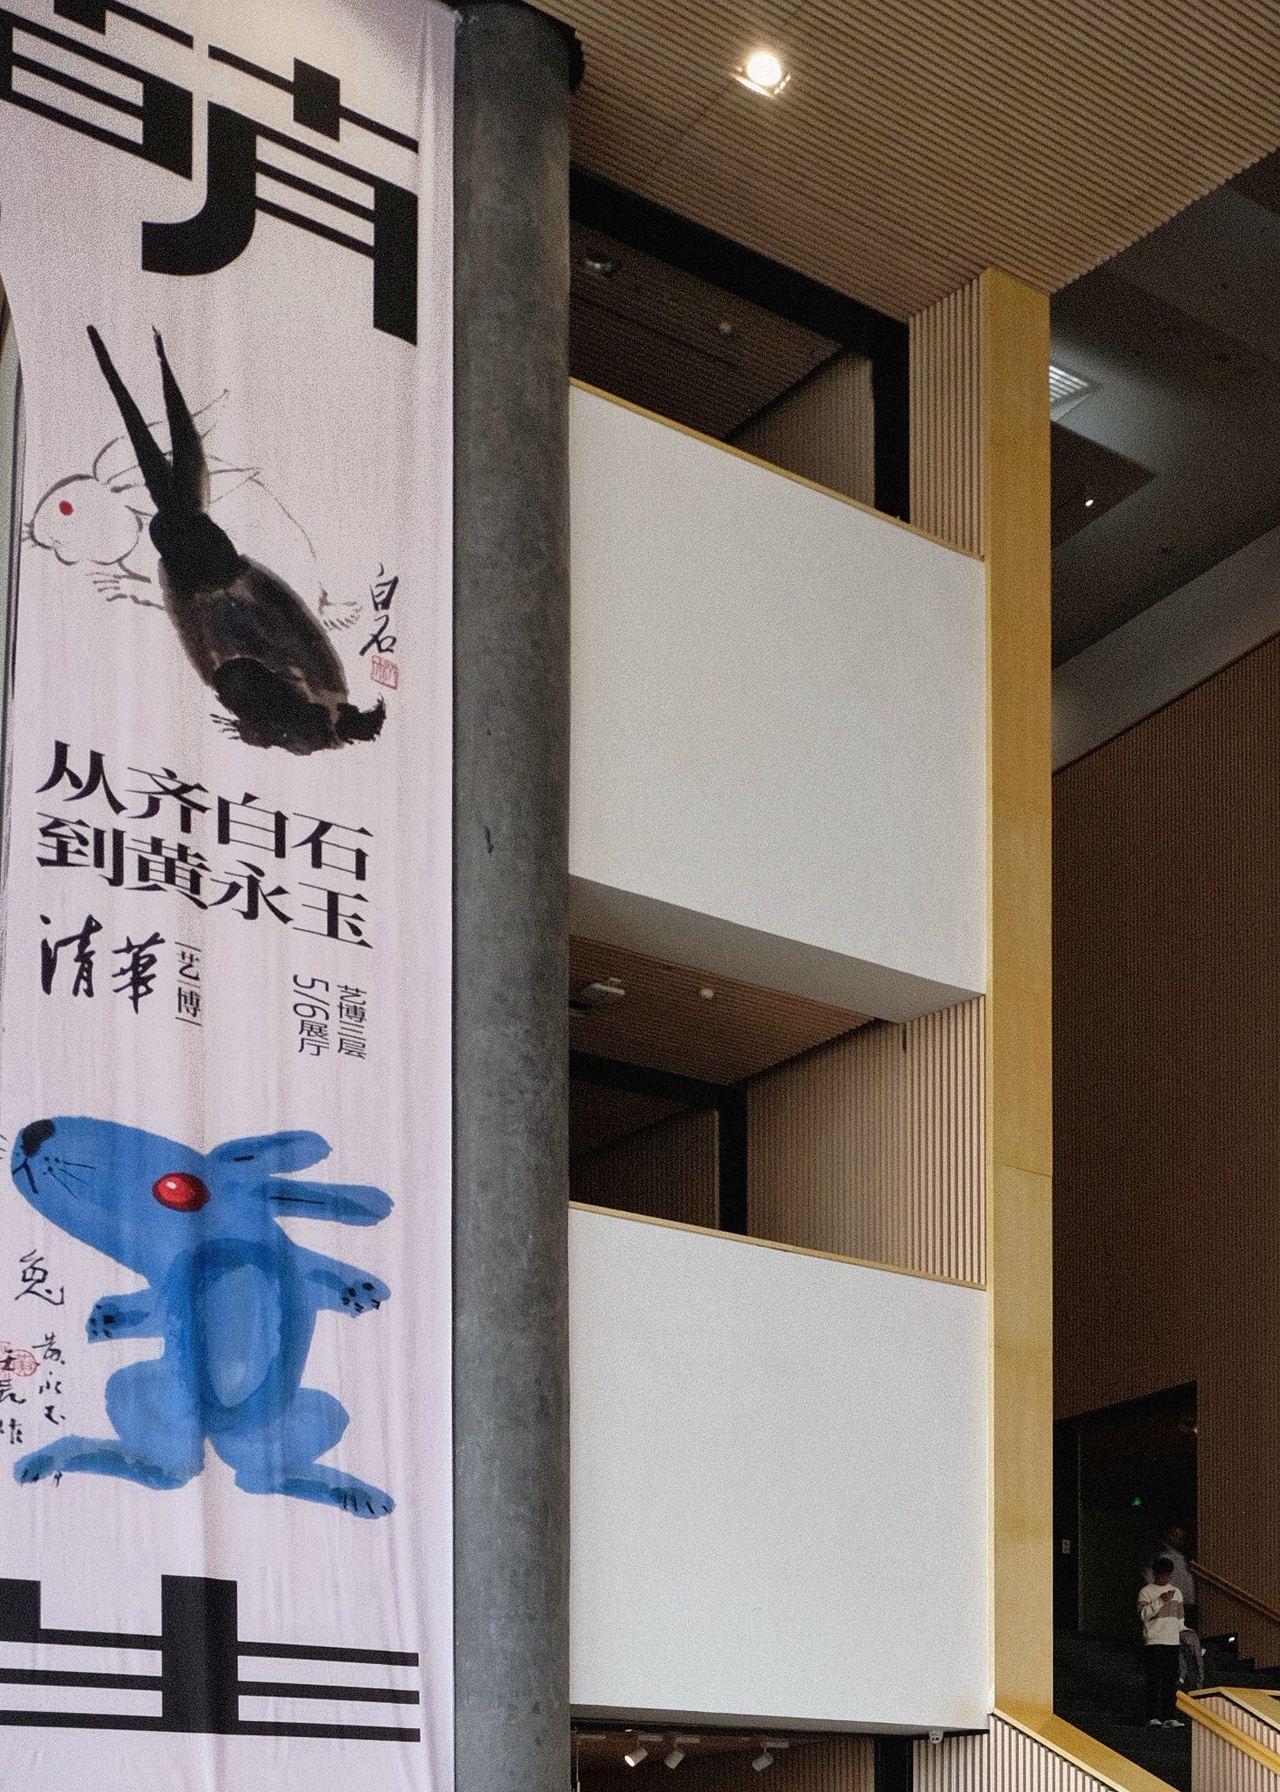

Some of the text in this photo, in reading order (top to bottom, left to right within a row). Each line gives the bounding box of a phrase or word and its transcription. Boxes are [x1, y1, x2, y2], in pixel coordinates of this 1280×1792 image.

[349, 562, 399, 656] 白石
[35, 740, 374, 882] 从齐白石
[36, 812, 374, 950] 到黄永玉
